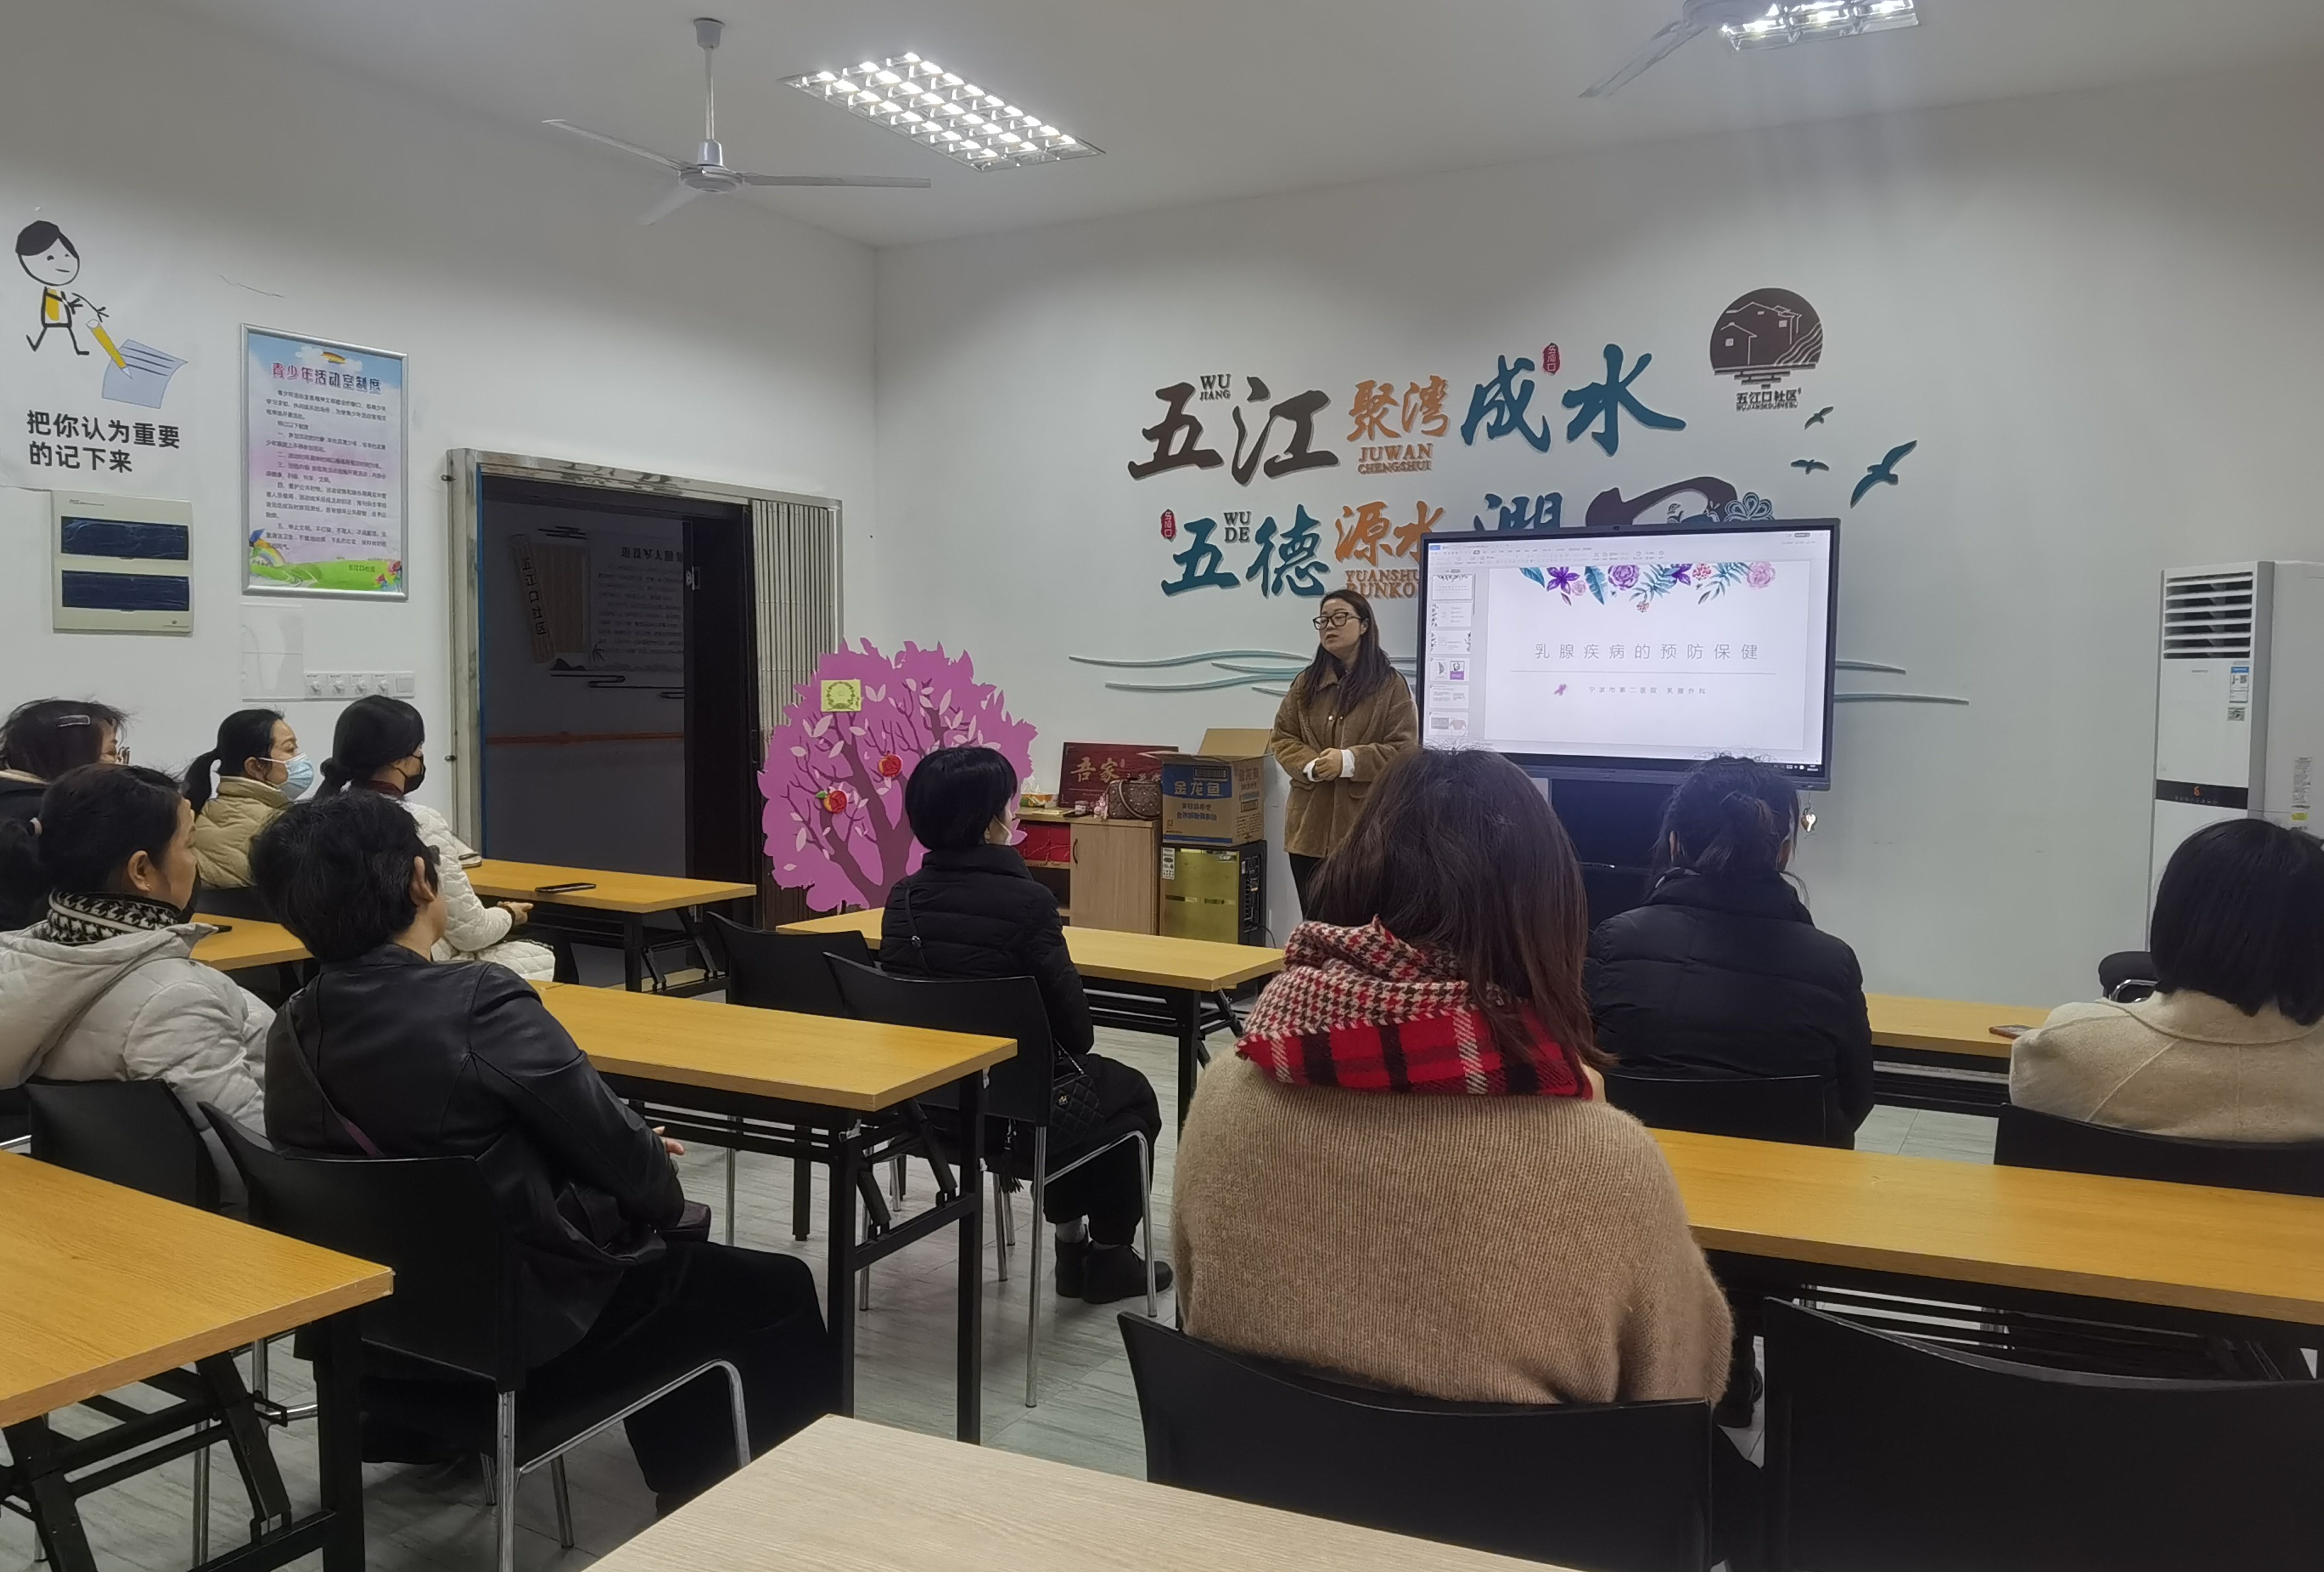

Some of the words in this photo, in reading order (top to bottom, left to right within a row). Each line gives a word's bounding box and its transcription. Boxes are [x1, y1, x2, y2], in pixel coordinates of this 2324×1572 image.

[272, 363, 381, 393] 青少年活动室制度
[1199, 374, 1231, 390] WU
[1199, 389, 1231, 401] JIANG
[1737, 390, 1797, 404] 五江口社区
[26, 409, 181, 450] 把你认为重要
[1128, 376, 1340, 486] 五江
[28, 441, 133, 473] 的记下来
[1358, 443, 1434, 463] JUWAN
[1357, 460, 1433, 475] CHENGSHUI
[1224, 511, 1252, 526] WU
[1224, 526, 1251, 543] DE
[1161, 504, 1331, 599] 五德
[1345, 569, 1419, 583] YUANSHU
[1534, 642, 1759, 661] 乳腺疾病的预防保健
[1589, 686, 1657, 694] 宁波市第二医院
[1173, 781, 1222, 797] 金龙鱼
